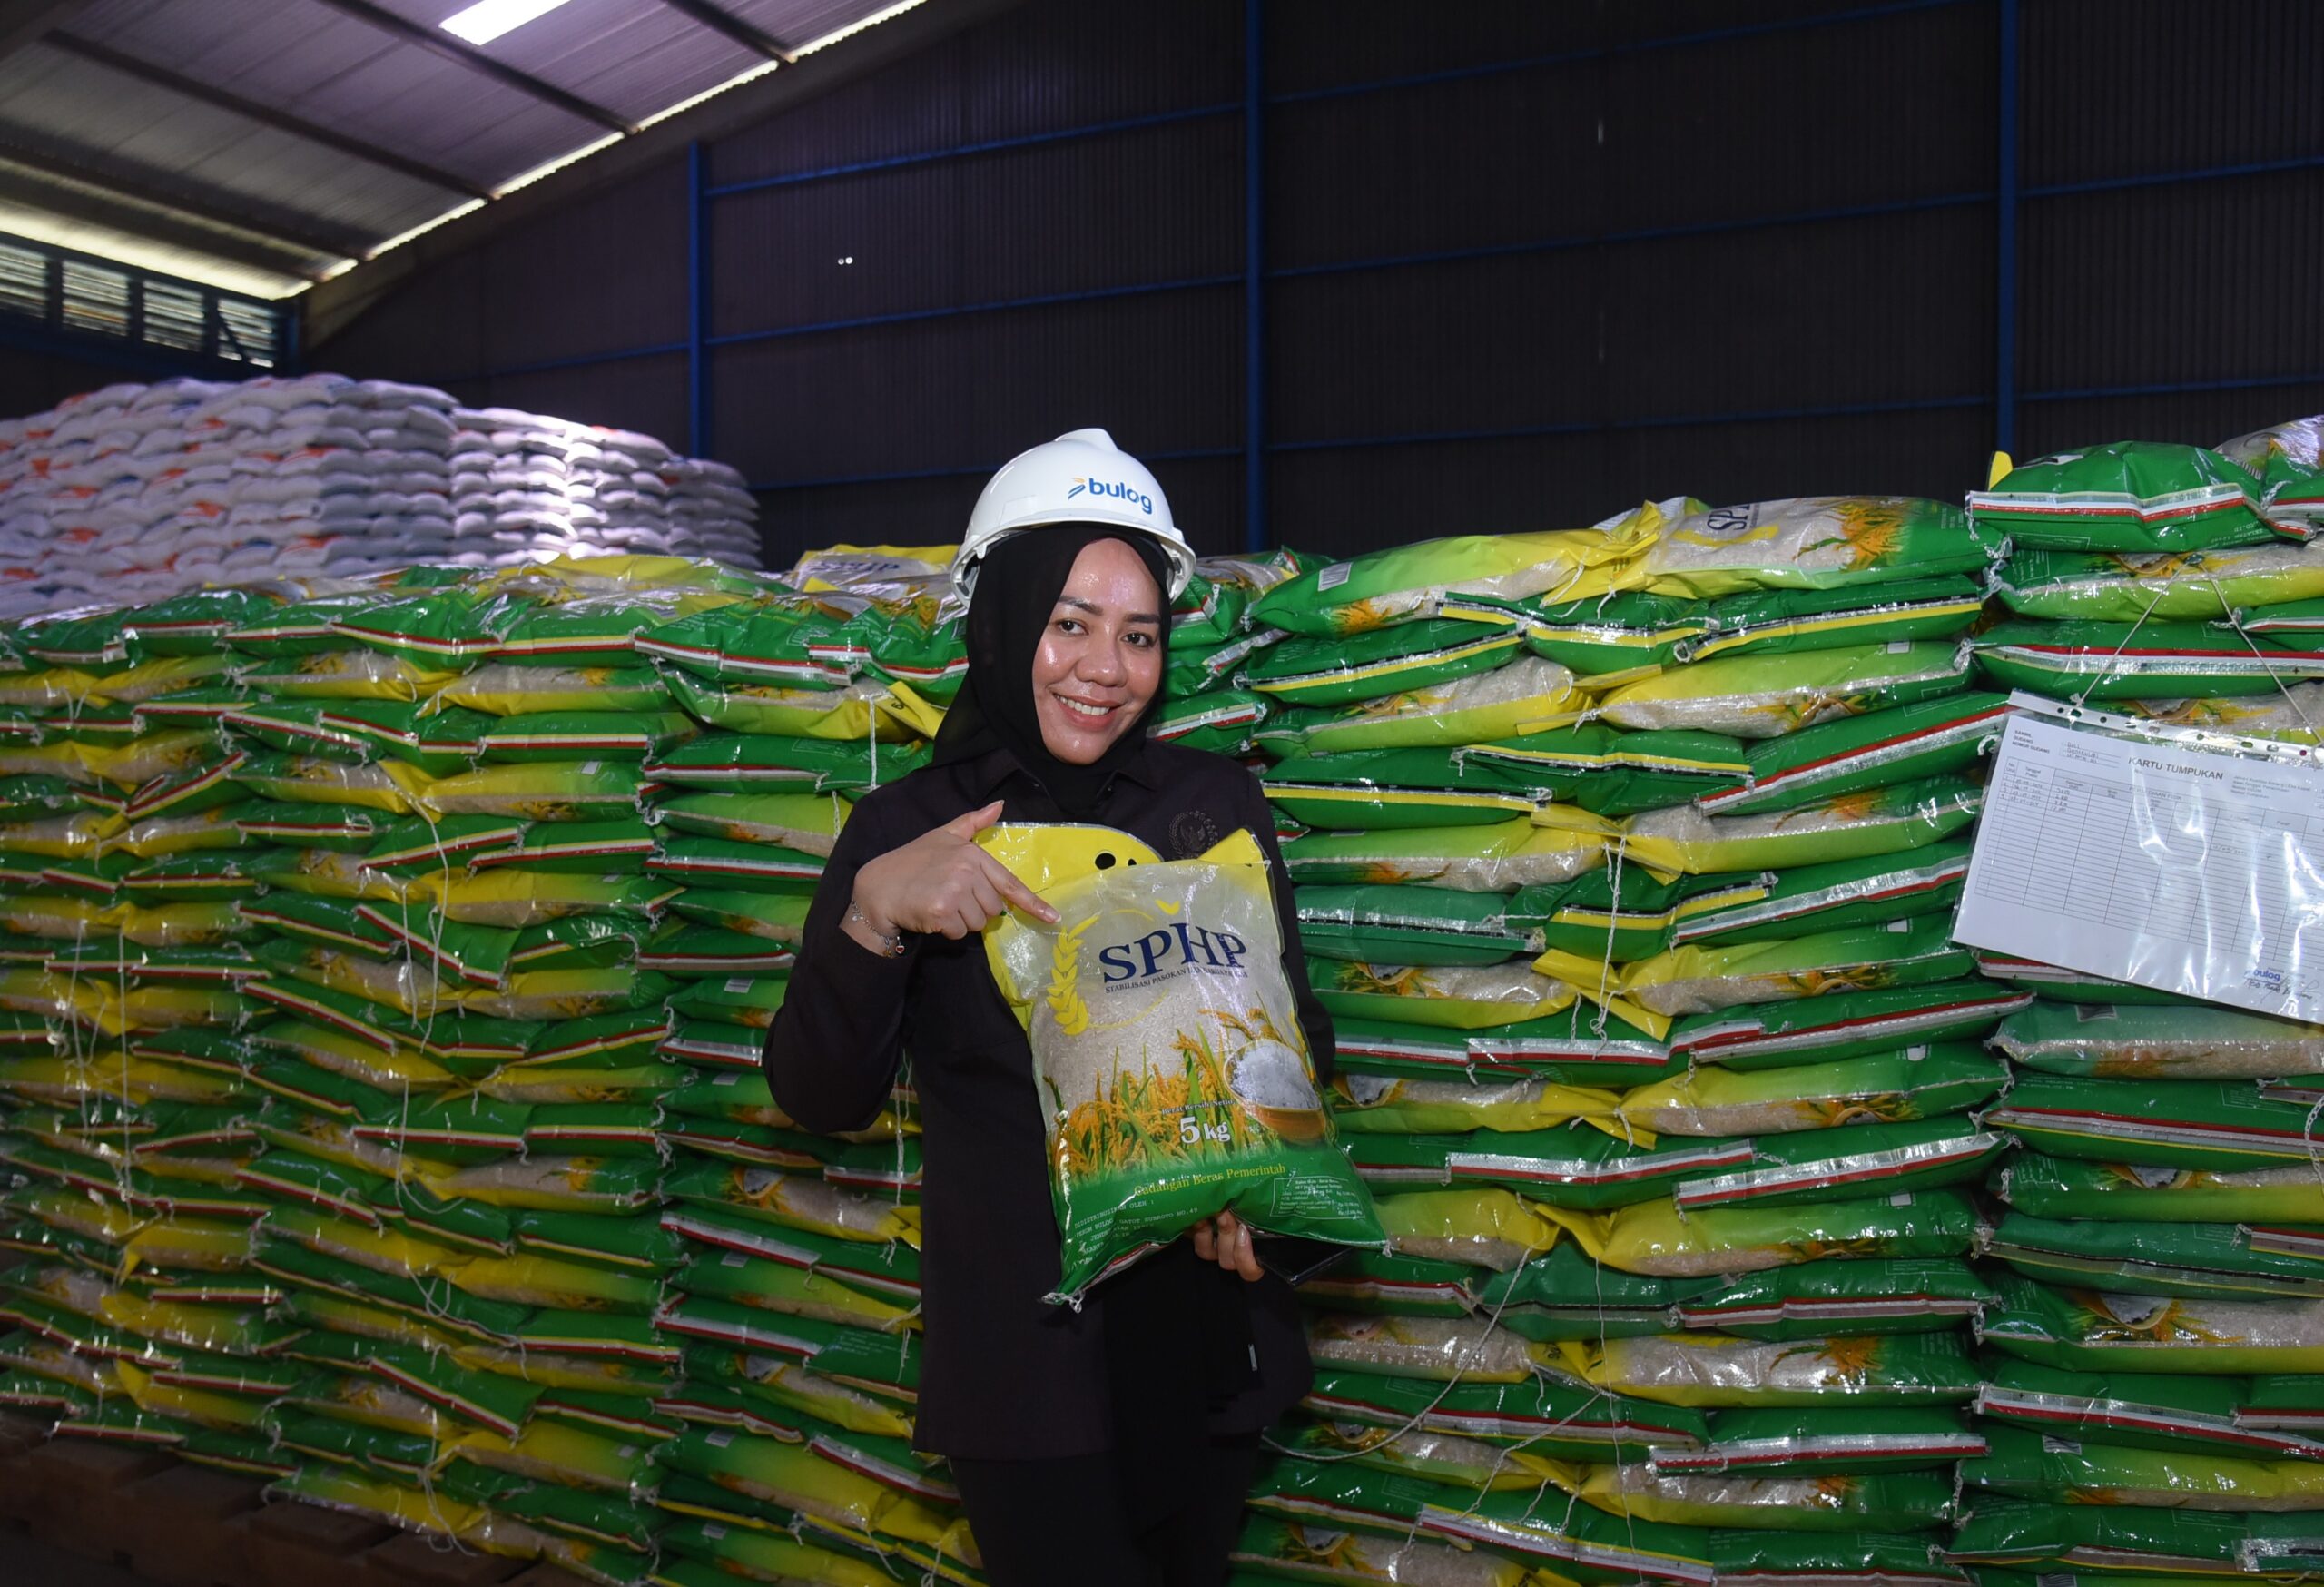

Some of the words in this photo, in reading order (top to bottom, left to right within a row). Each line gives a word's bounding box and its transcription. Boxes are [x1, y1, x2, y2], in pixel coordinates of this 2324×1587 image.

[1088, 478, 1153, 515] bulog
[1707, 504, 1750, 530] SP
[2128, 756, 2163, 771] KARTU
[2165, 764, 2224, 781] TUMPUKAN
[1098, 922, 1247, 983] SPHP
[1105, 979, 1151, 994] STABILISASI
[1152, 968, 1187, 985] PASOKAN
[1180, 1116, 1201, 1144] 5
[1203, 1122, 1231, 1142] kg
[1134, 1178, 1190, 1197] Cadangan
[1193, 1172, 1224, 1185] Beras
[1226, 1163, 1286, 1179] Pemerintah
[1129, 1200, 1147, 1209] OLEH
